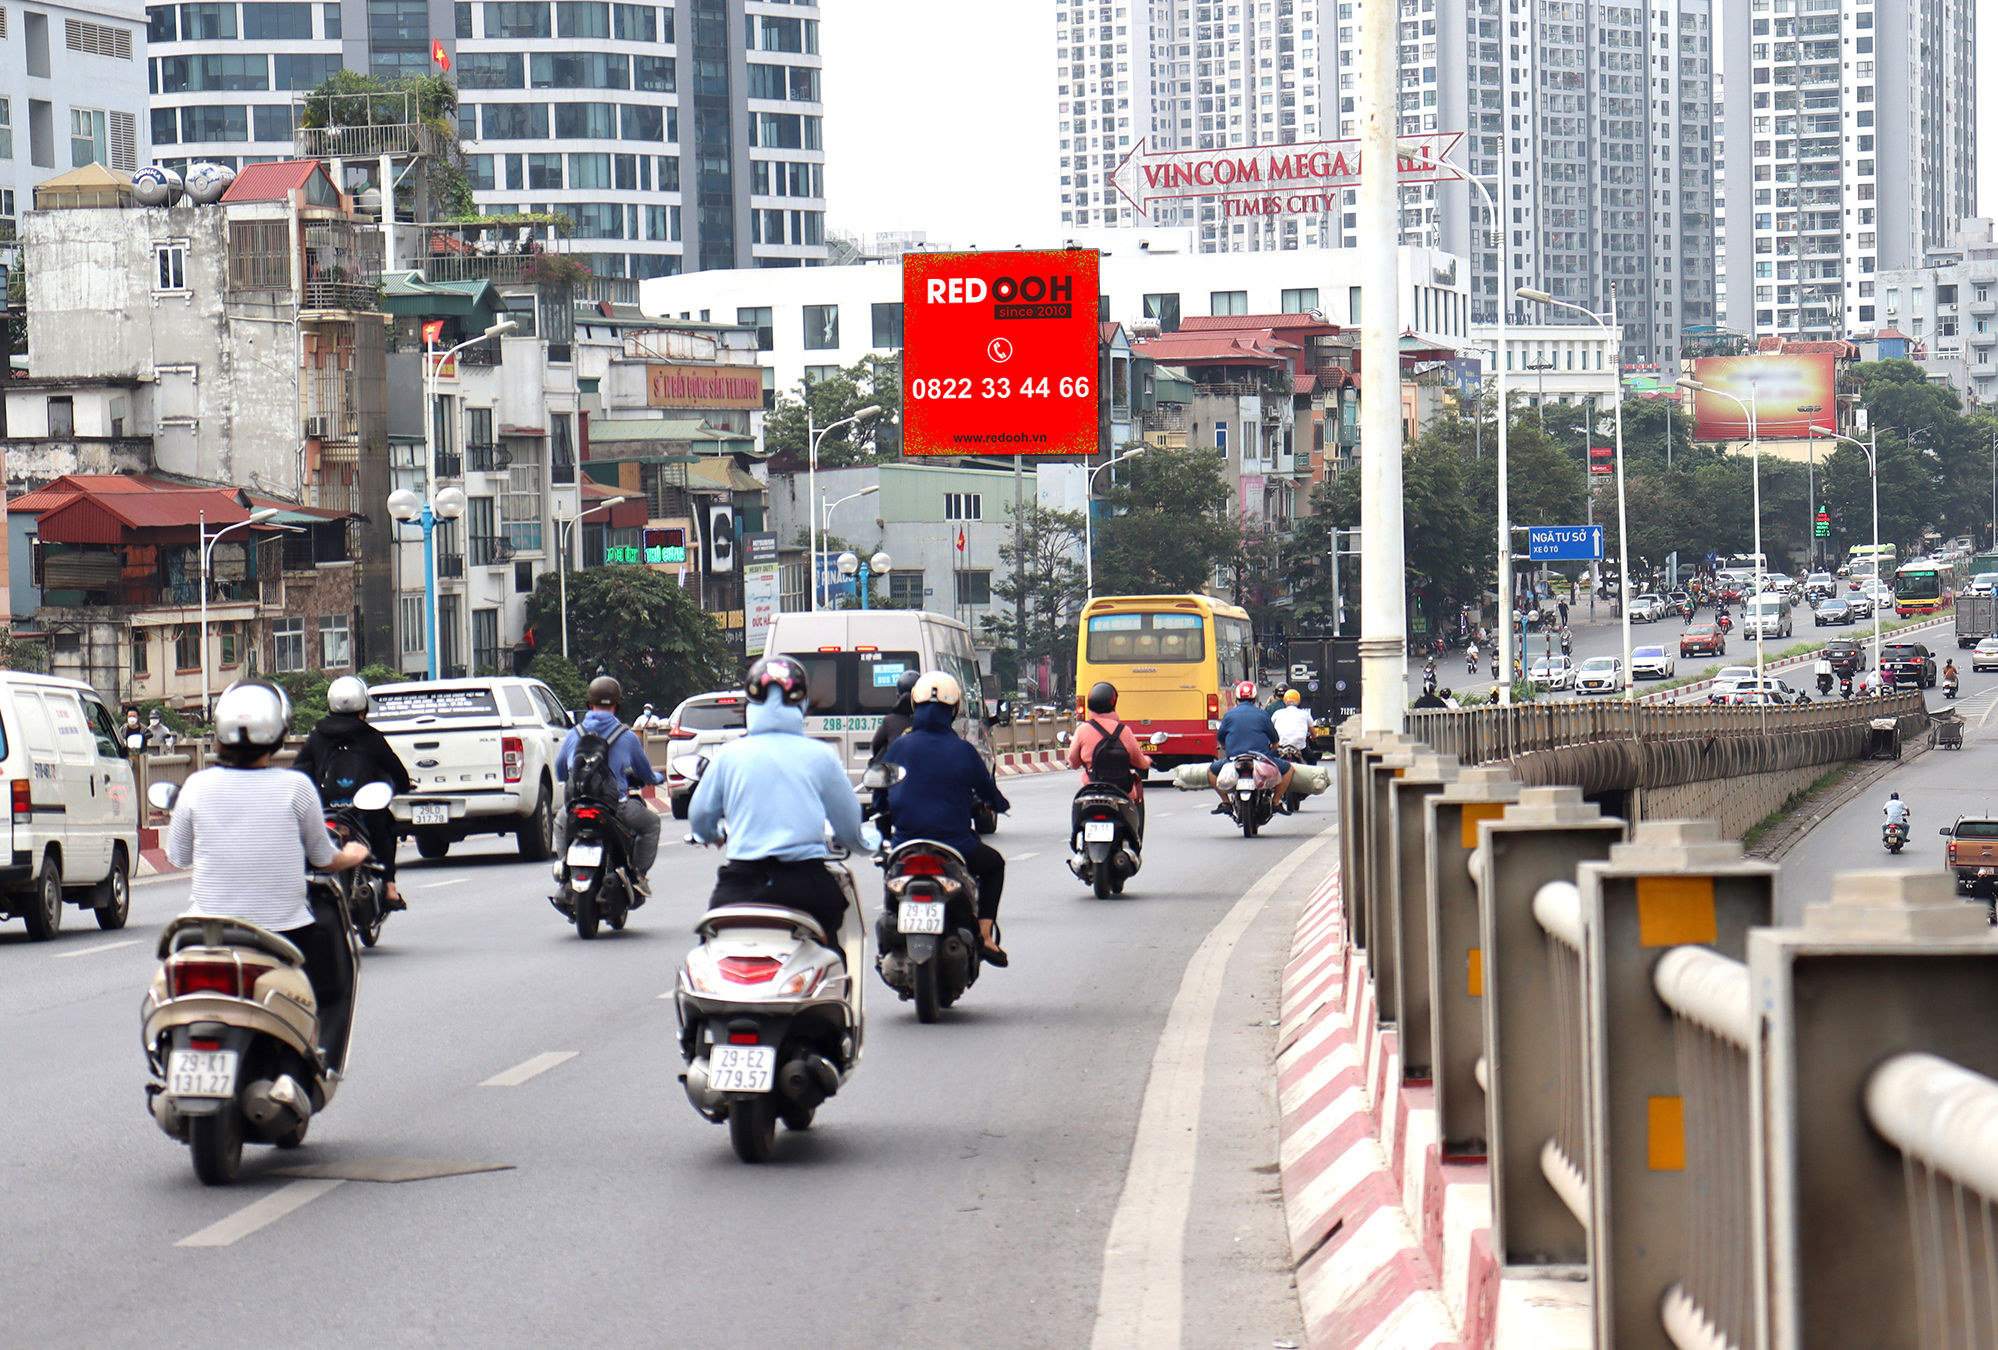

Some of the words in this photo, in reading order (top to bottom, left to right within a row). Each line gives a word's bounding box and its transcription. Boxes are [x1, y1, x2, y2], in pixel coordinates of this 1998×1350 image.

[1142, 156, 1258, 189] VINCOM
[1268, 150, 1352, 181] MEGA
[1221, 196, 1282, 217] TIMES
[1286, 193, 1336, 214] CITY
[927, 277, 987, 304] RED
[991, 275, 1072, 303] OOH
[999, 307, 1033, 317] since
[1037, 306, 1067, 316] 2010
[912, 378, 972, 399] 0822
[981, 377, 1011, 398] 33
[1019, 377, 1050, 398] 44
[1059, 376, 1090, 397] 66
[953, 432, 1047, 442] www.redooh.vn
[1532, 531, 1555, 542] NGÃ
[1555, 532, 1570, 542] TƯ
[1571, 529, 1587, 541] SỞ
[1543, 545, 1548, 553] Ô
[1550, 545, 1559, 553] TÔ
[763, 564, 773, 572] DUTY
[877, 676, 890, 684] BUS
[903, 919, 940, 932] 172.07
[180, 1054, 226, 1072] 29-K1
[721, 1050, 764, 1068] 29-E2
[174, 1074, 229, 1093] 131.27
[713, 1070, 768, 1088] 779.57
